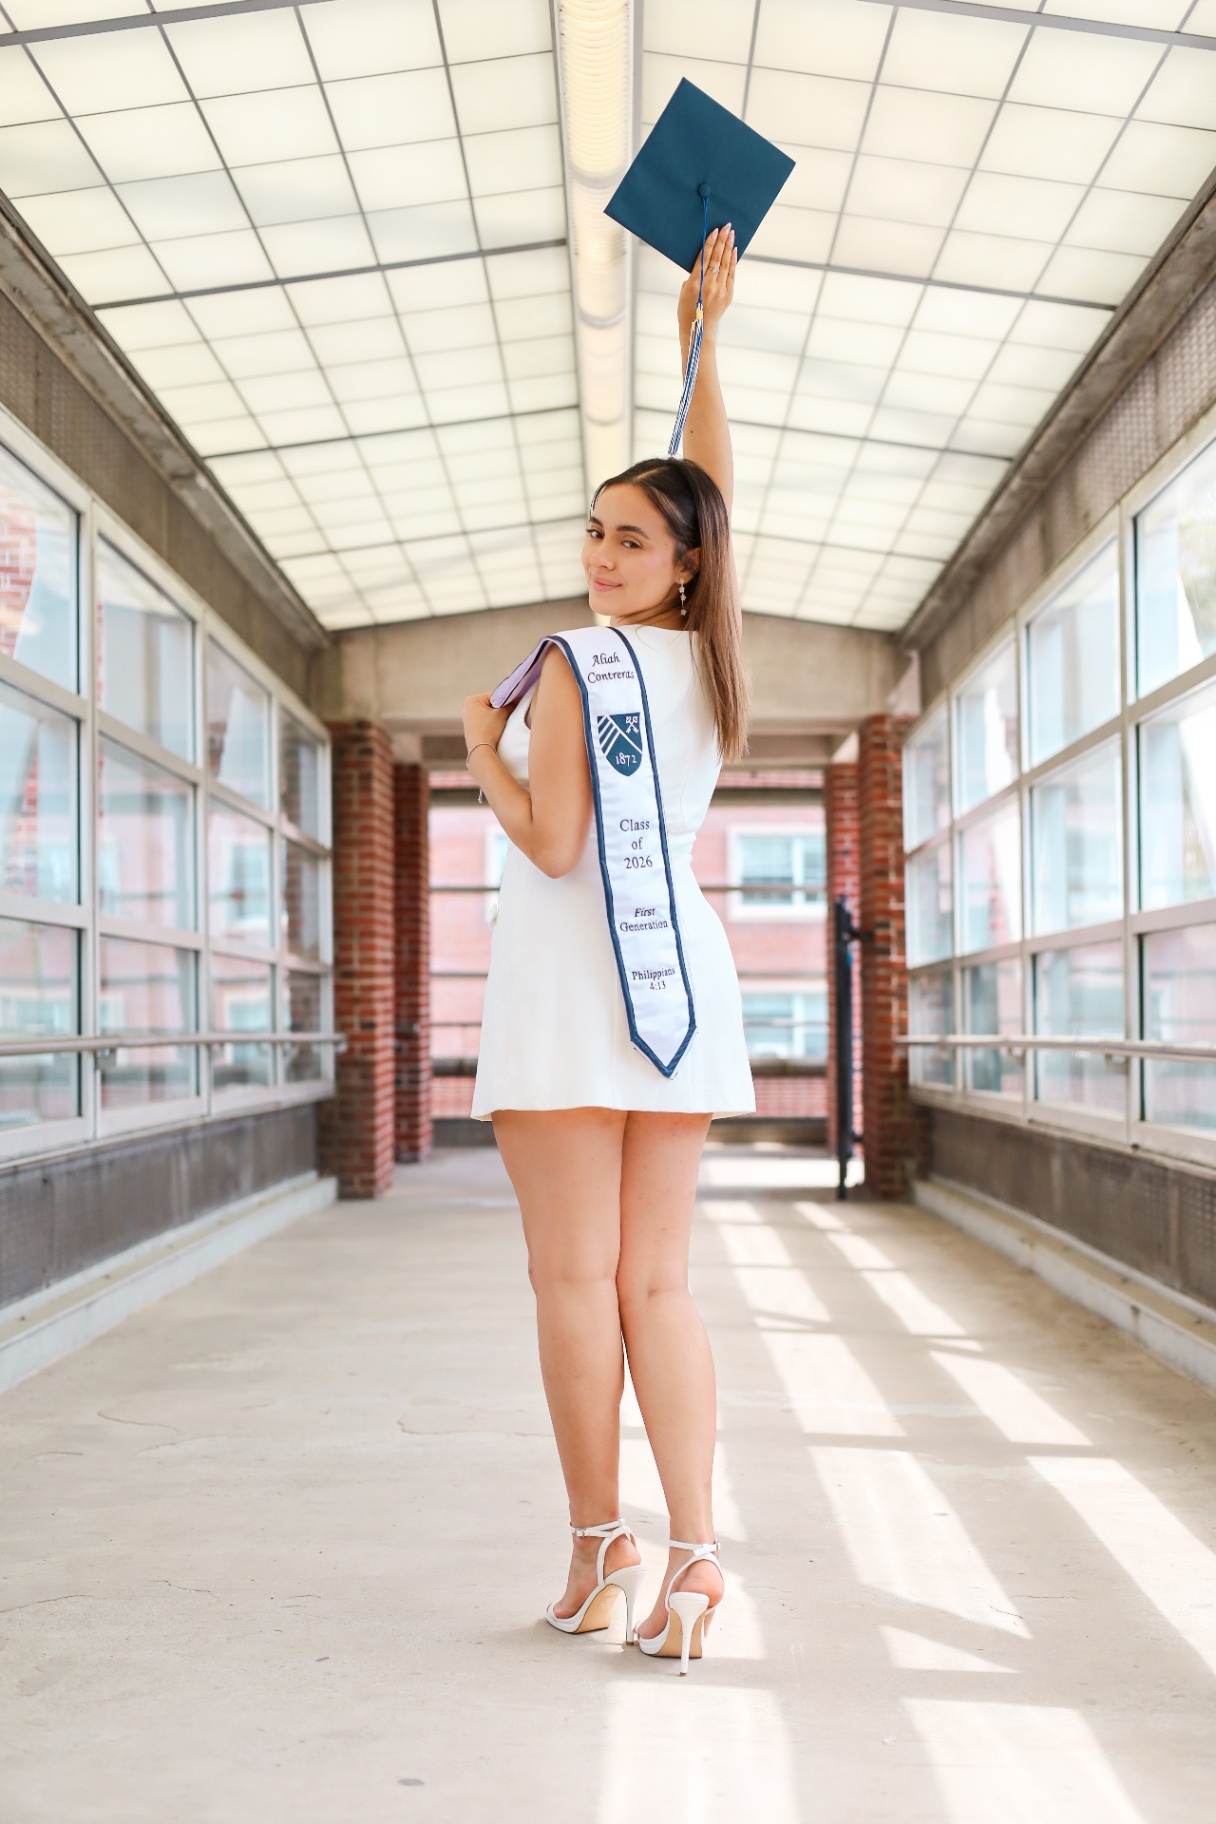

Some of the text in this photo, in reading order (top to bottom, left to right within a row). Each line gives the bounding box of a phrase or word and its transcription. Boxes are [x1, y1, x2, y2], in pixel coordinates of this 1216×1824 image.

[592, 652, 621, 667] Aliah
[587, 670, 635, 683] Contreras
[615, 752, 637, 767] 1872
[619, 819, 650, 832] Class
[631, 837, 643, 850] of
[624, 856, 653, 869] 2026
[634, 907, 656, 918] First
[619, 920, 668, 932] Generation
[631, 967, 676, 981] Philippians
[649, 980, 666, 991] 4:13
